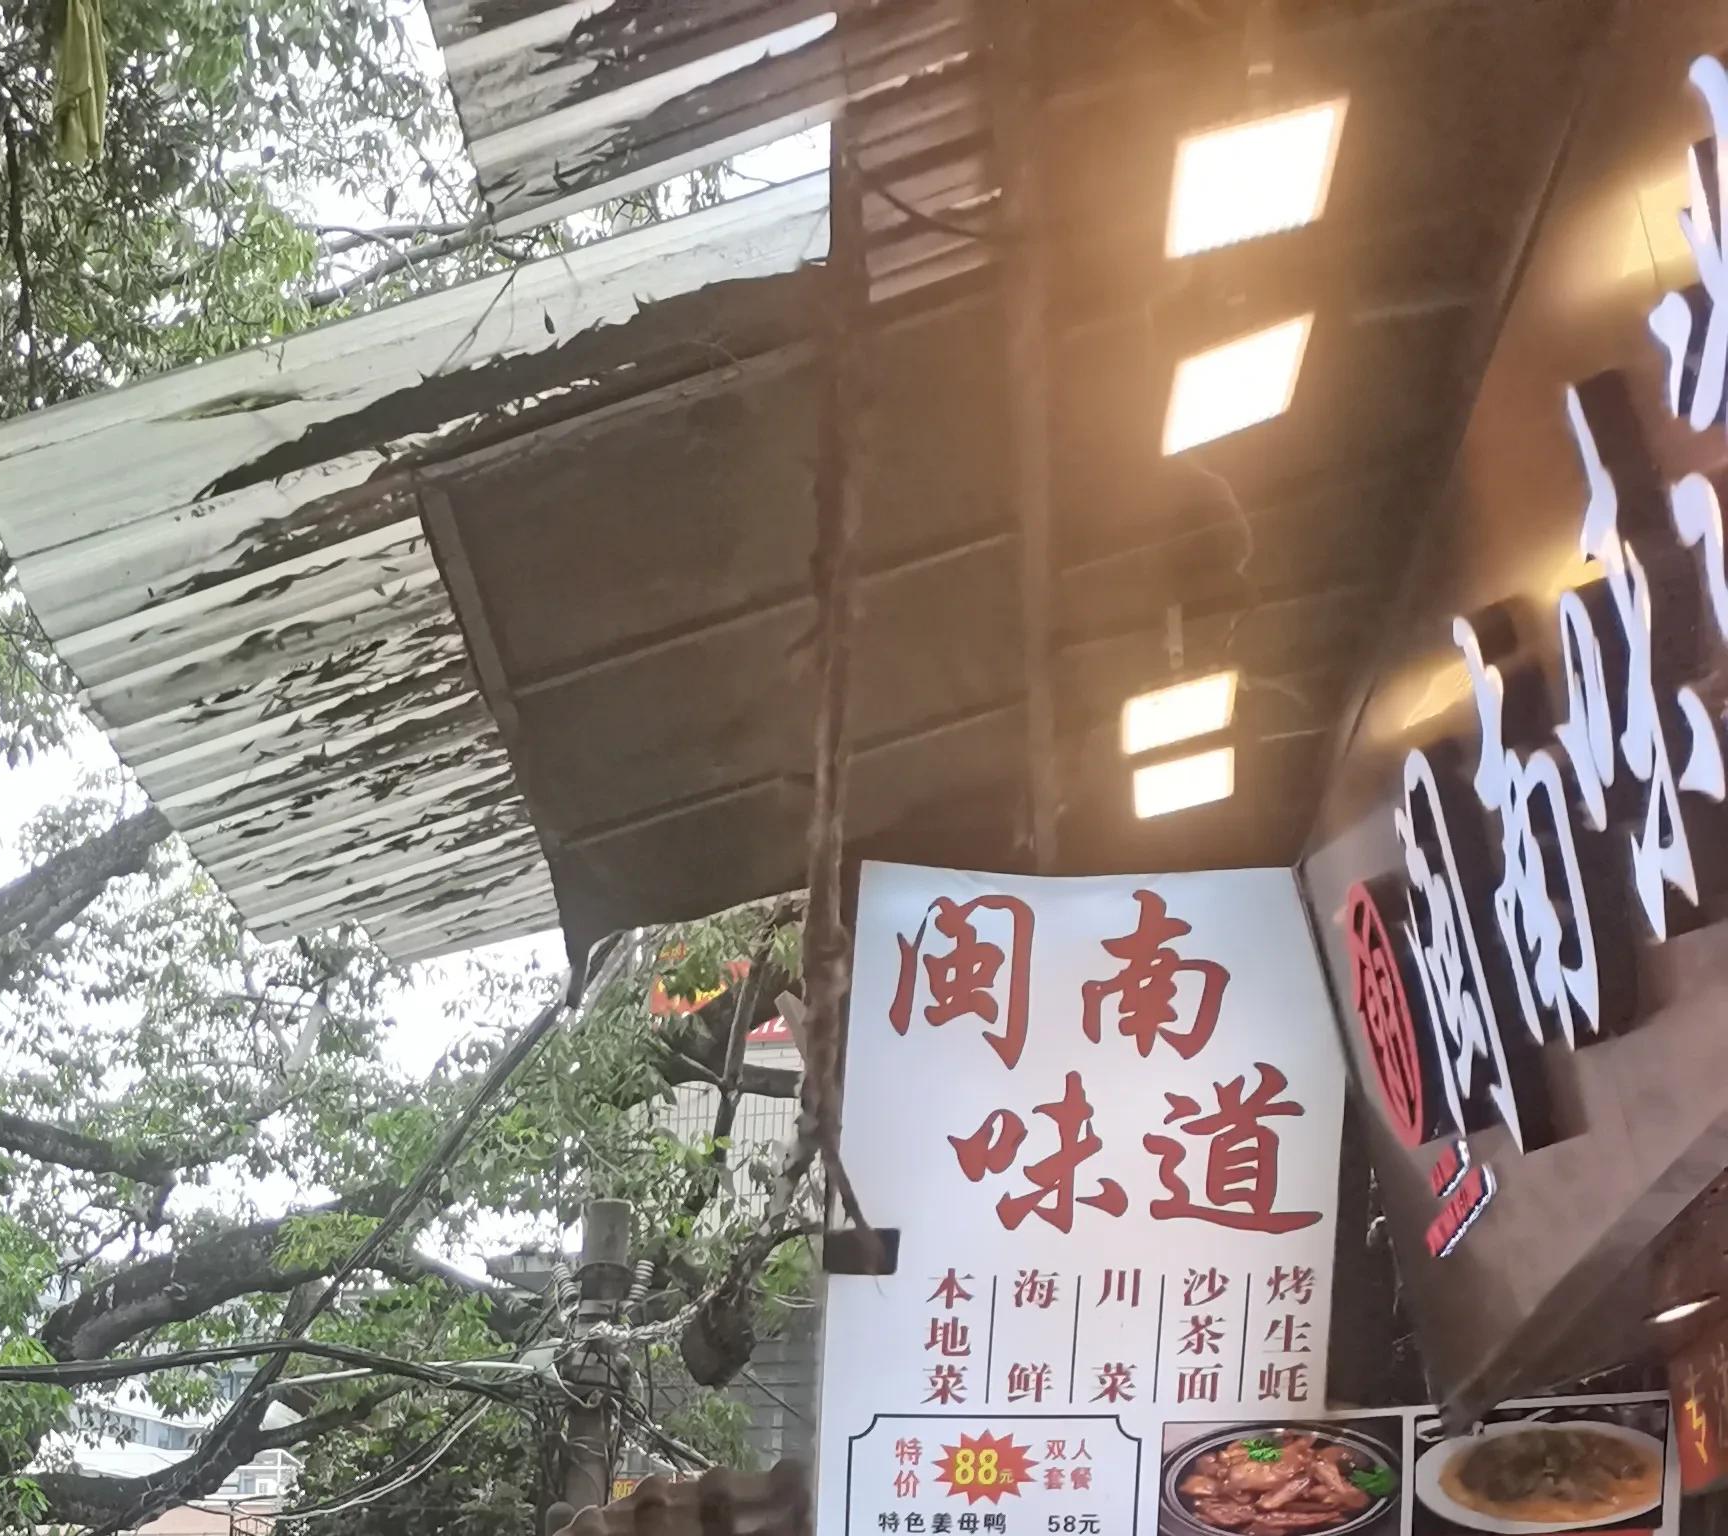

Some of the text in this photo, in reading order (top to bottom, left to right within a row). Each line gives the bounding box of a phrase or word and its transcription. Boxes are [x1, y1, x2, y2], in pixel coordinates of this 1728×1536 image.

[888, 890, 1231, 1070] 闽南
[947, 1062, 1323, 1234] 味道
[922, 1268, 974, 1405] 本地菜
[1006, 1268, 1058, 1404] 海鲜
[1089, 1268, 1140, 1404] 川菜
[1175, 1266, 1229, 1403] 沙茶面
[1256, 1265, 1315, 1401] 烤生蚝
[878, 1511, 1101, 1535] 特色姜母鸭 58元
[894, 1437, 923, 1499] 特价
[955, 1448, 1014, 1486] 88元
